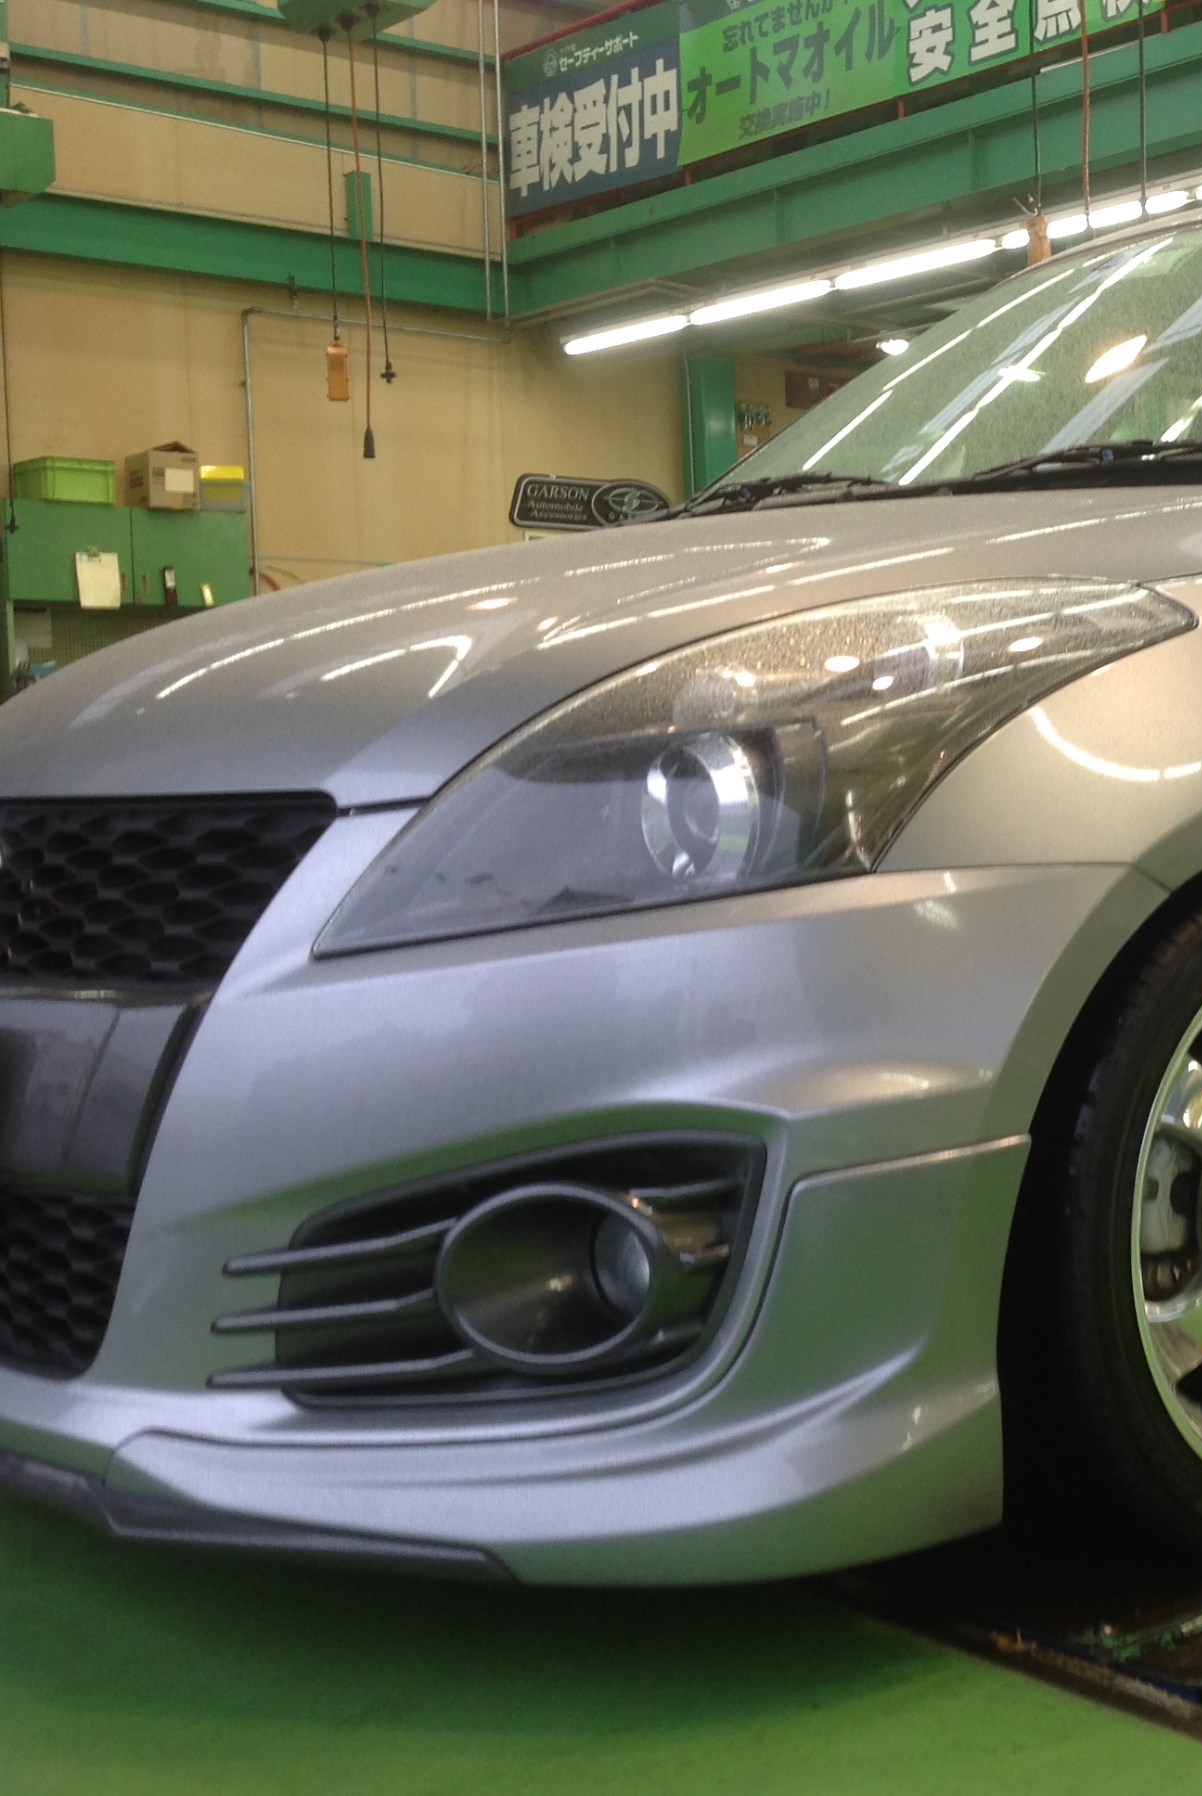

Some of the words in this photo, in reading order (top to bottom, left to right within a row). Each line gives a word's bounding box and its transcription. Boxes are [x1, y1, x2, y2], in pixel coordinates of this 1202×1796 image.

[559, 31, 639, 72] セーフティーサポート
[687, 0, 895, 124] オートマオイル
[908, 0, 1150, 83] 安全点
[509, 58, 679, 197] 車検受付中
[526, 483, 590, 502] GARSON
